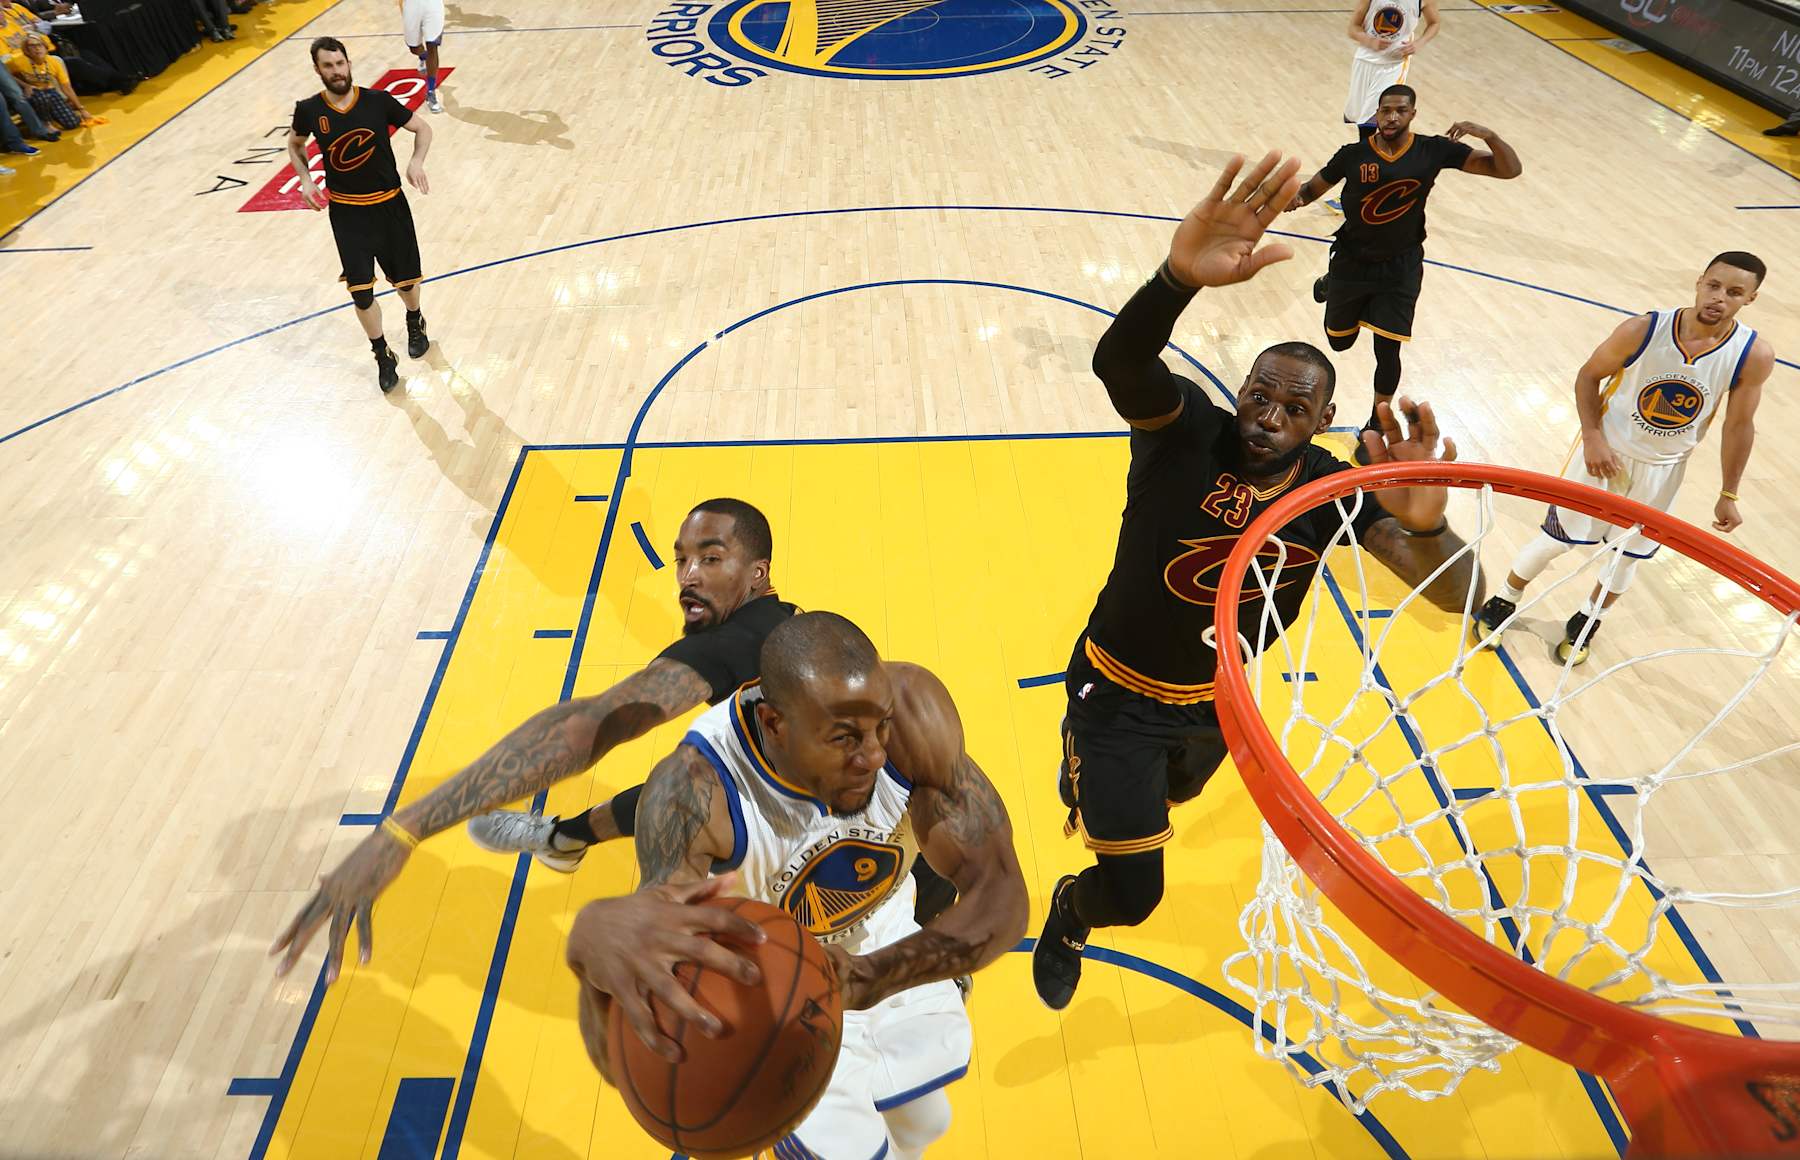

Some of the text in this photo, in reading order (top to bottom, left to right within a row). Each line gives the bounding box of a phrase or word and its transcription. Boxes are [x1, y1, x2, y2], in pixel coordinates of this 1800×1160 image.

[646, 2, 769, 87] RRIORS
[1028, 26, 1127, 79] STATE
[1727, 45, 1769, 81] 11PM
[318, 115, 331, 135] 0
[194, 113, 296, 196] ENA
[1360, 162, 1380, 184] 13
[1644, 373, 1712, 398] GOLDEN STATE
[1671, 392, 1698, 409] 30
[1631, 411, 1696, 437] WARRIORS
[1200, 472, 1254, 529] 23
[772, 827, 905, 894] GOLDEN STATE
[853, 856, 879, 883] 9
